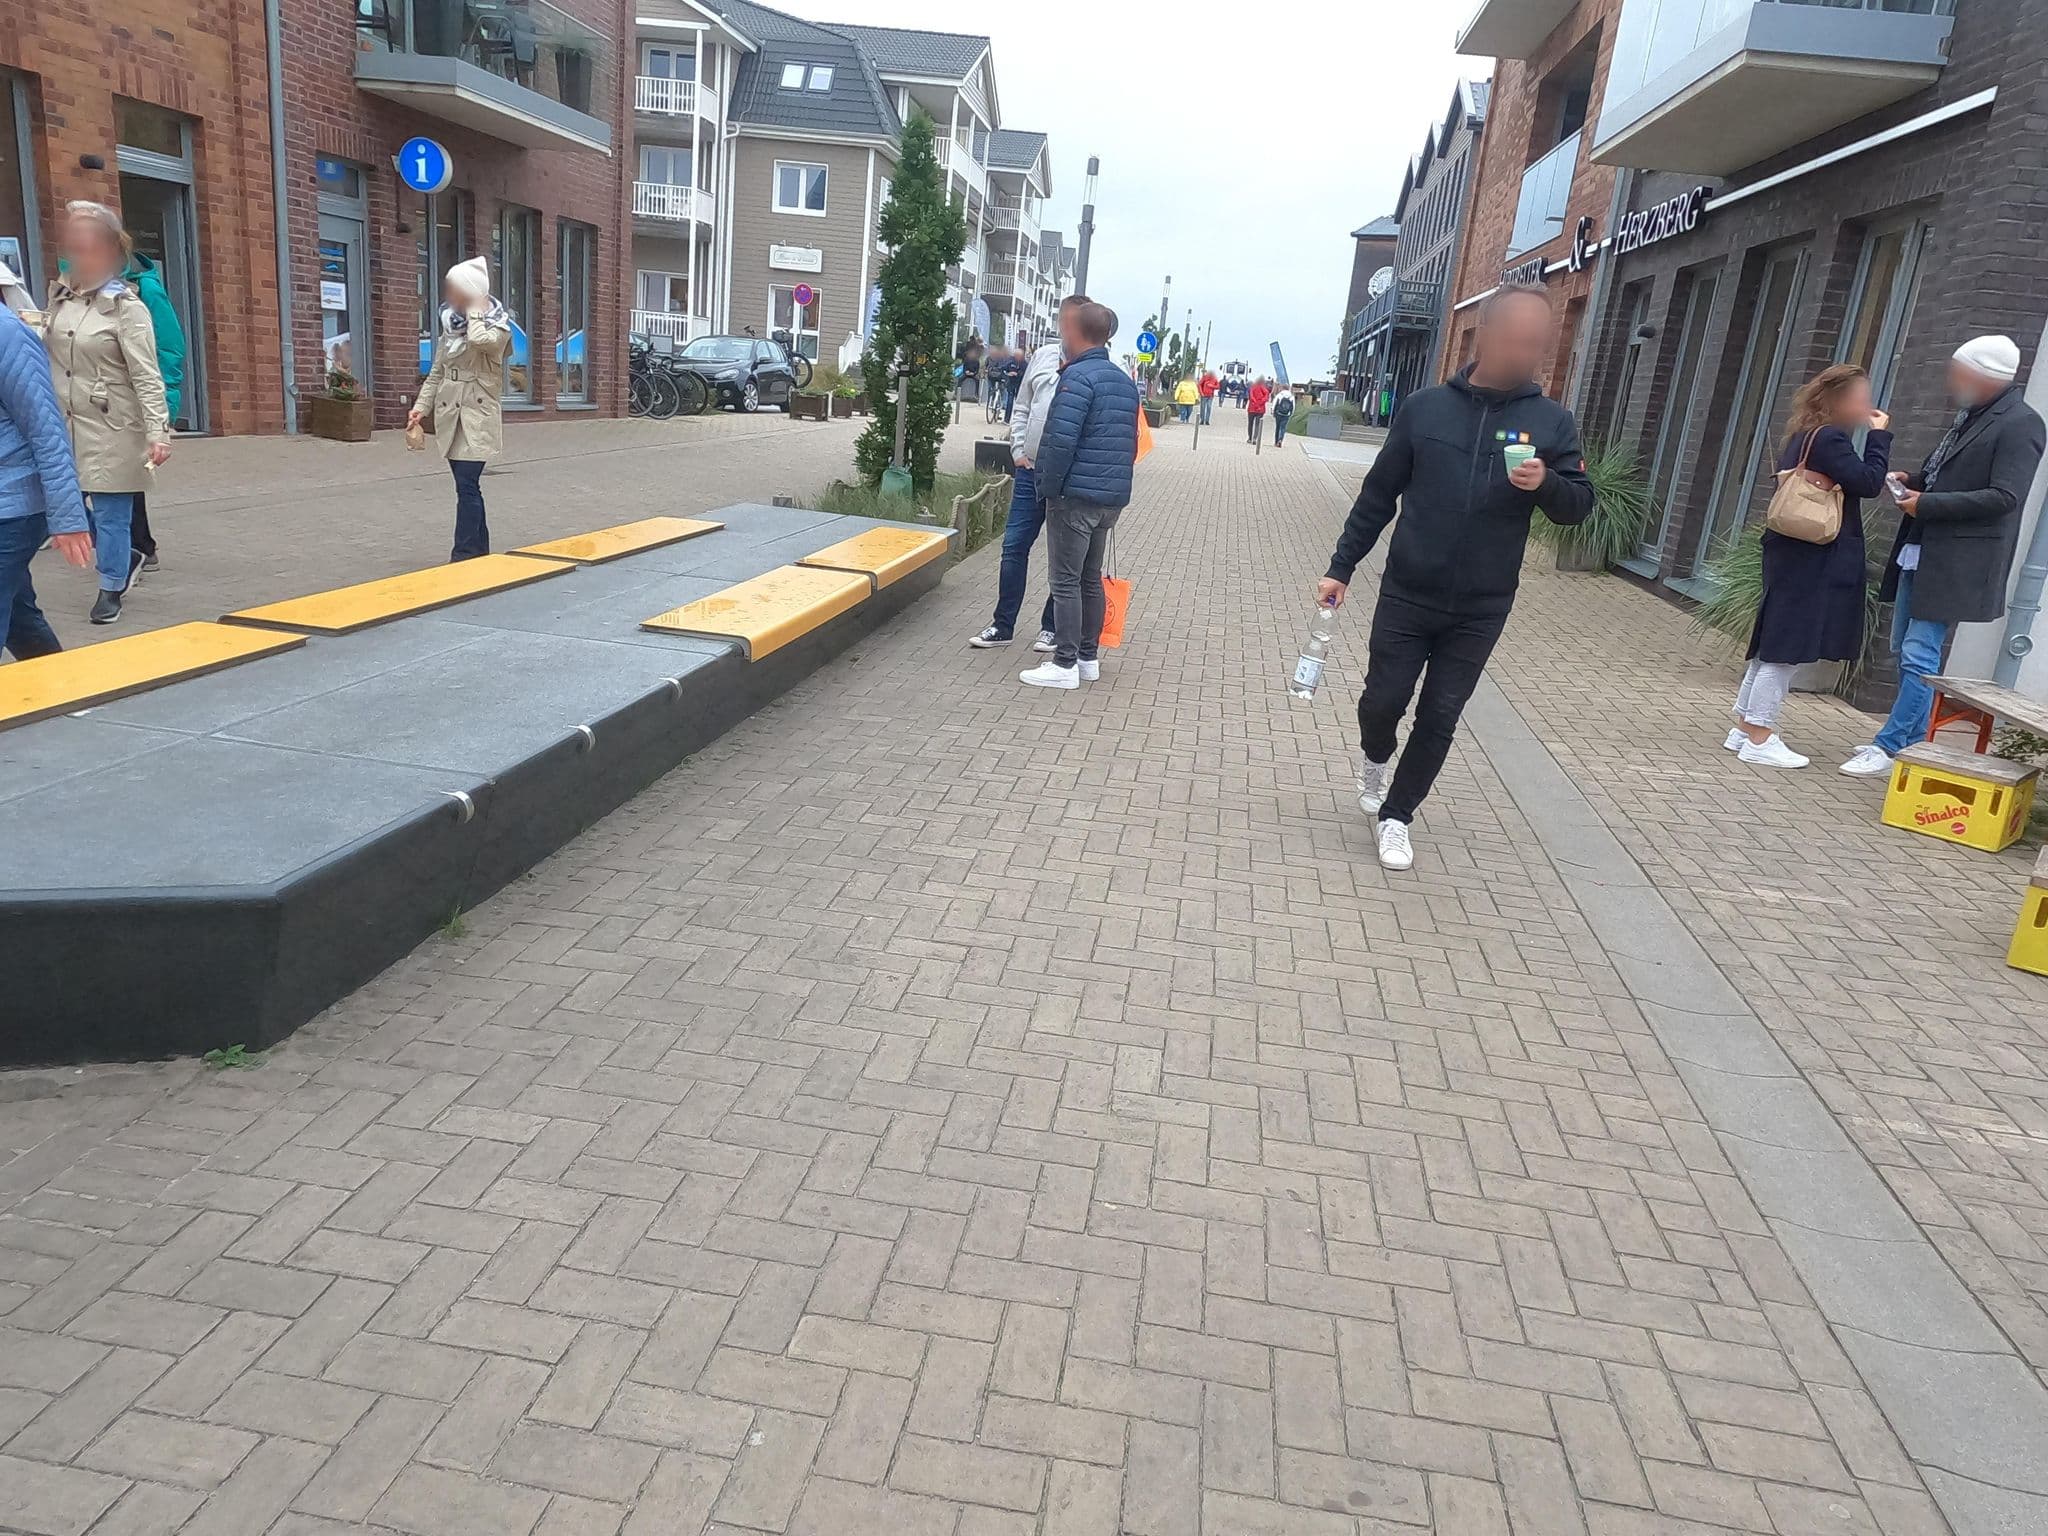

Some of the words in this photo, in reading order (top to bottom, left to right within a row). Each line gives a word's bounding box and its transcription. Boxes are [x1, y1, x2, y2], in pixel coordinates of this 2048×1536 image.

[414, 144, 430, 184] i
[1568, 215, 1590, 273] &
[1613, 186, 1703, 256] HERZBERG
[1914, 804, 1970, 826] Sinalco
